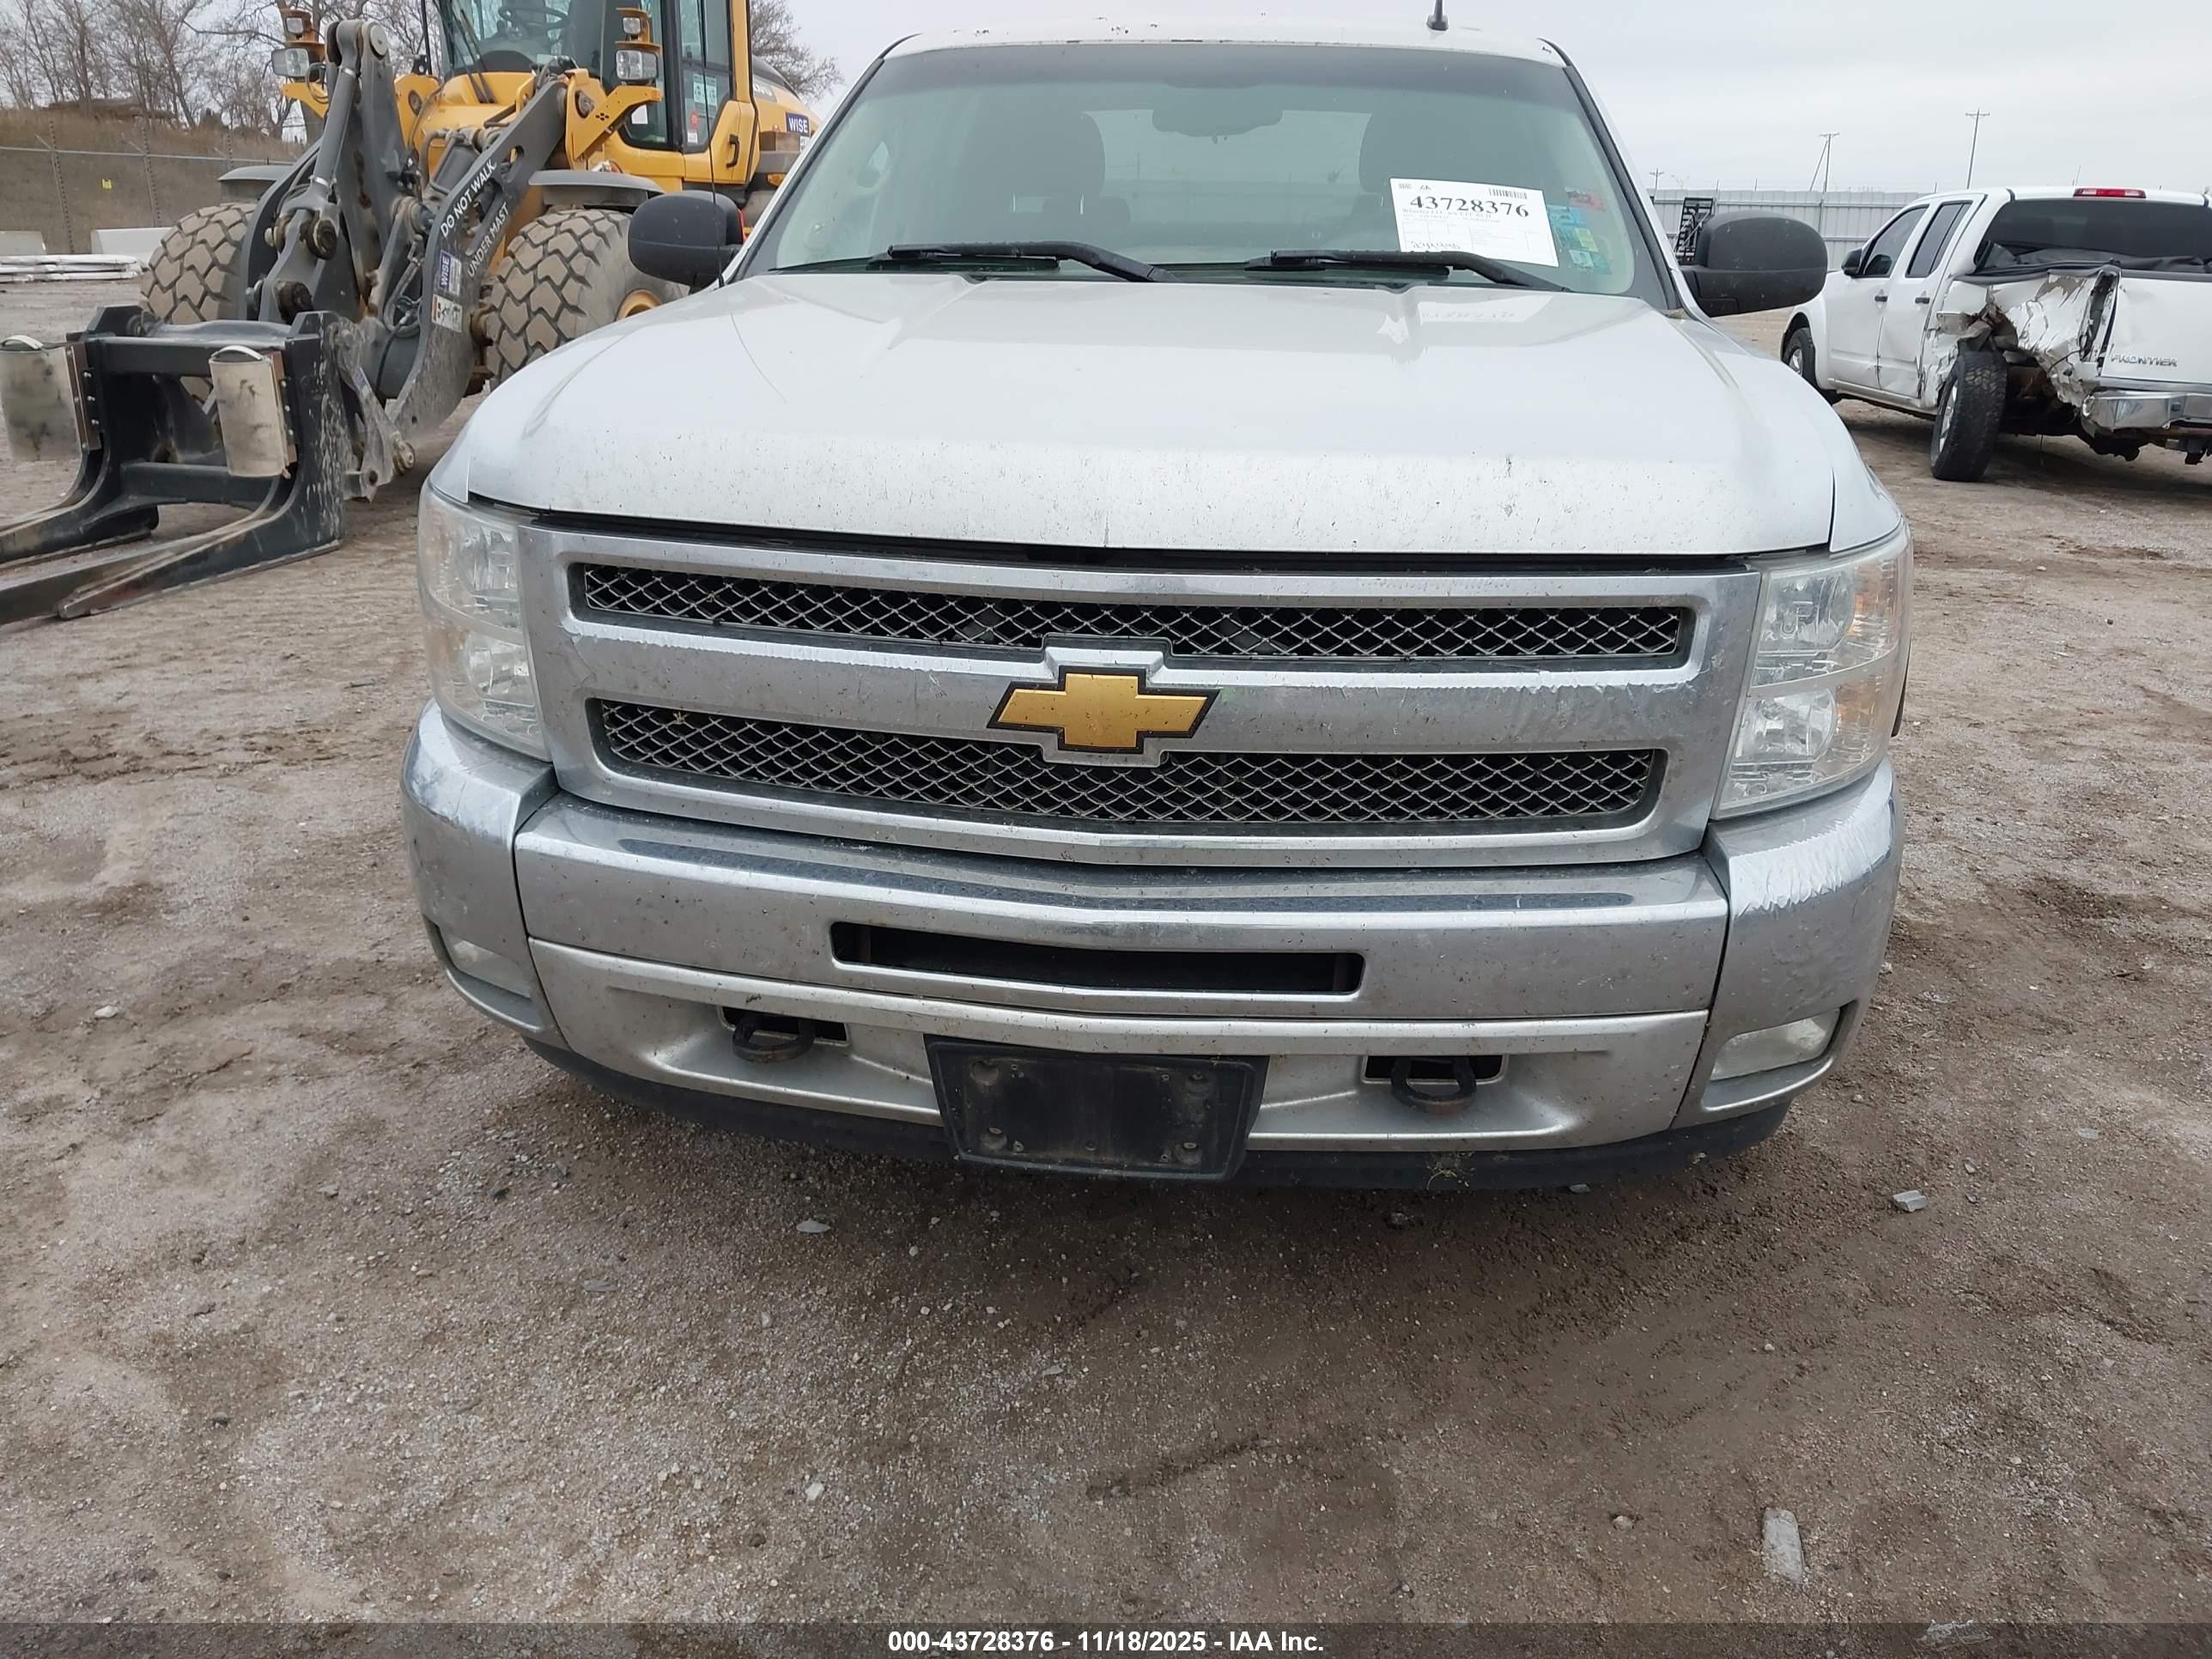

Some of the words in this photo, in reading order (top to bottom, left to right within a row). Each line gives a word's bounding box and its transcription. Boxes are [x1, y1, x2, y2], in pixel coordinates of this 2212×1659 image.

[788, 117, 809, 133] WISE
[440, 214, 455, 238] DO
[453, 188, 472, 220] NOT
[471, 158, 497, 193] WALK
[1409, 195, 1529, 217] 43728376
[467, 235, 493, 278] UNDER
[489, 201, 509, 239] MAST
[441, 256, 450, 287] WISE
[2111, 353, 2178, 368] FRONTIER
